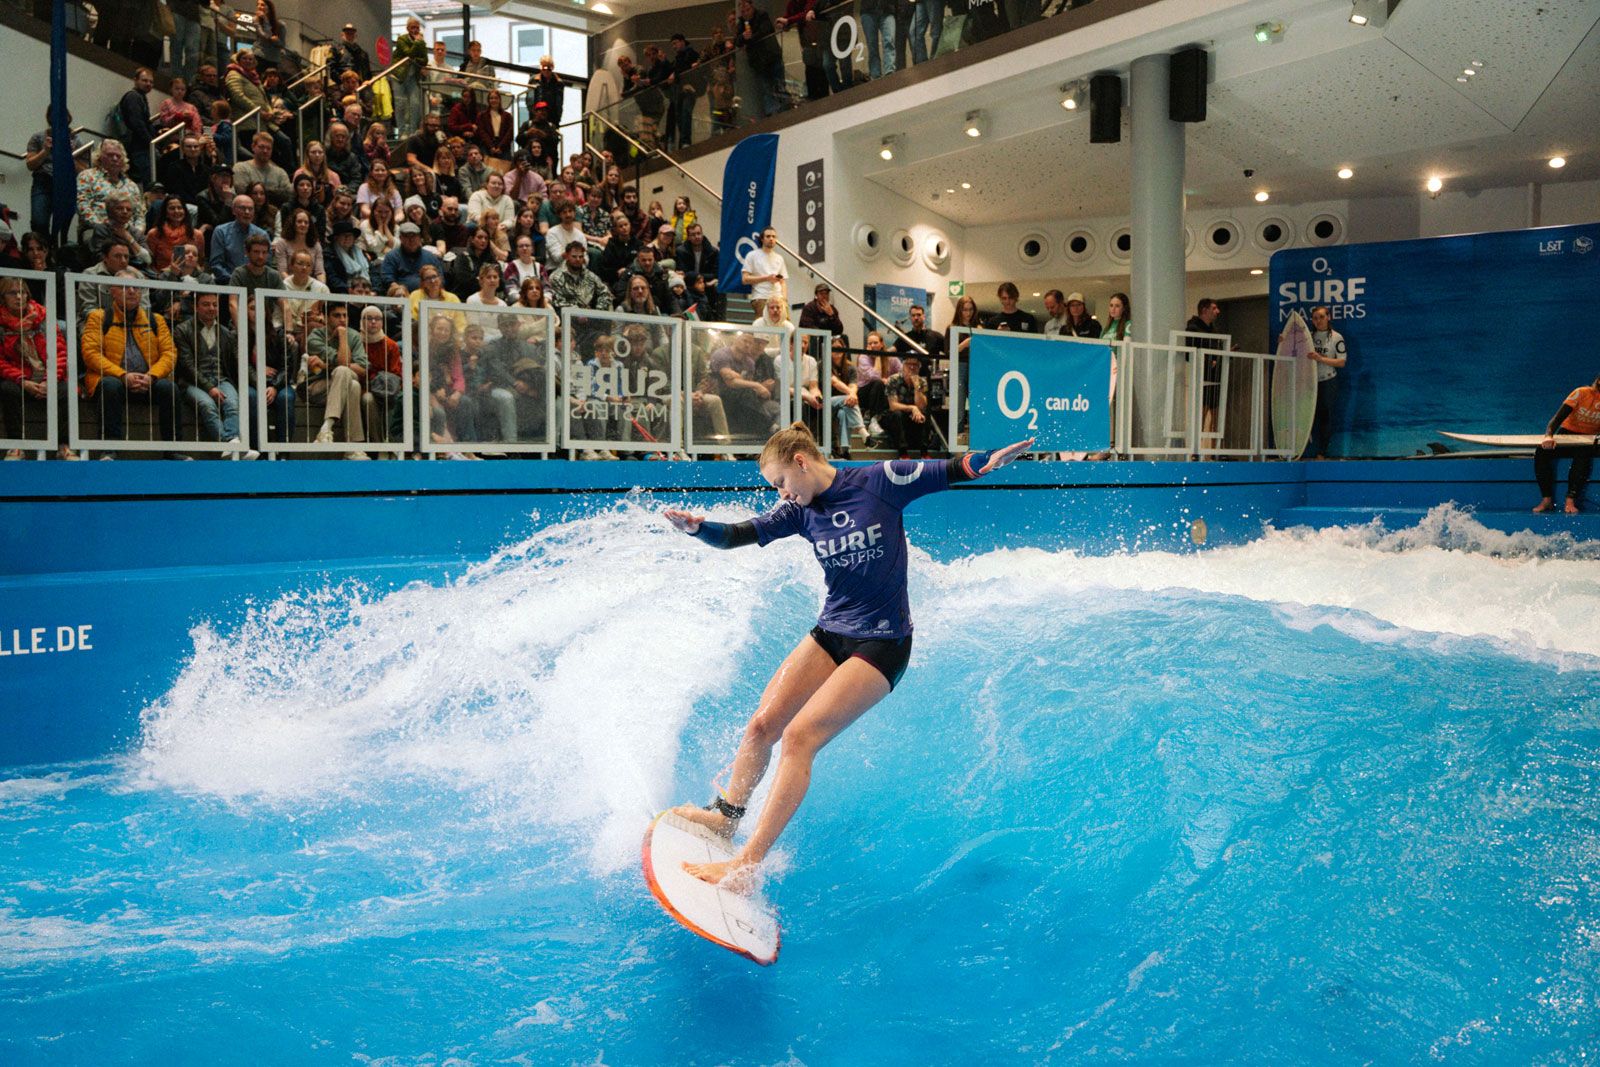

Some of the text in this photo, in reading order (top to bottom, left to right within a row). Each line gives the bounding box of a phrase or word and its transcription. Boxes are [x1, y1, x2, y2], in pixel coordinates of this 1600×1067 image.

[830, 15, 865, 63] O2
[747, 181, 757, 225] can do
[1539, 240, 1565, 253] L&T
[1312, 257, 1332, 276] O2
[1279, 277, 1366, 306] SURF
[1279, 303, 1366, 323] MAERS
[997, 370, 1090, 430] O2 can do
[831, 510, 857, 529] O2
[815, 523, 883, 560] SURF
[0, 625, 93, 656] LLE.DE
